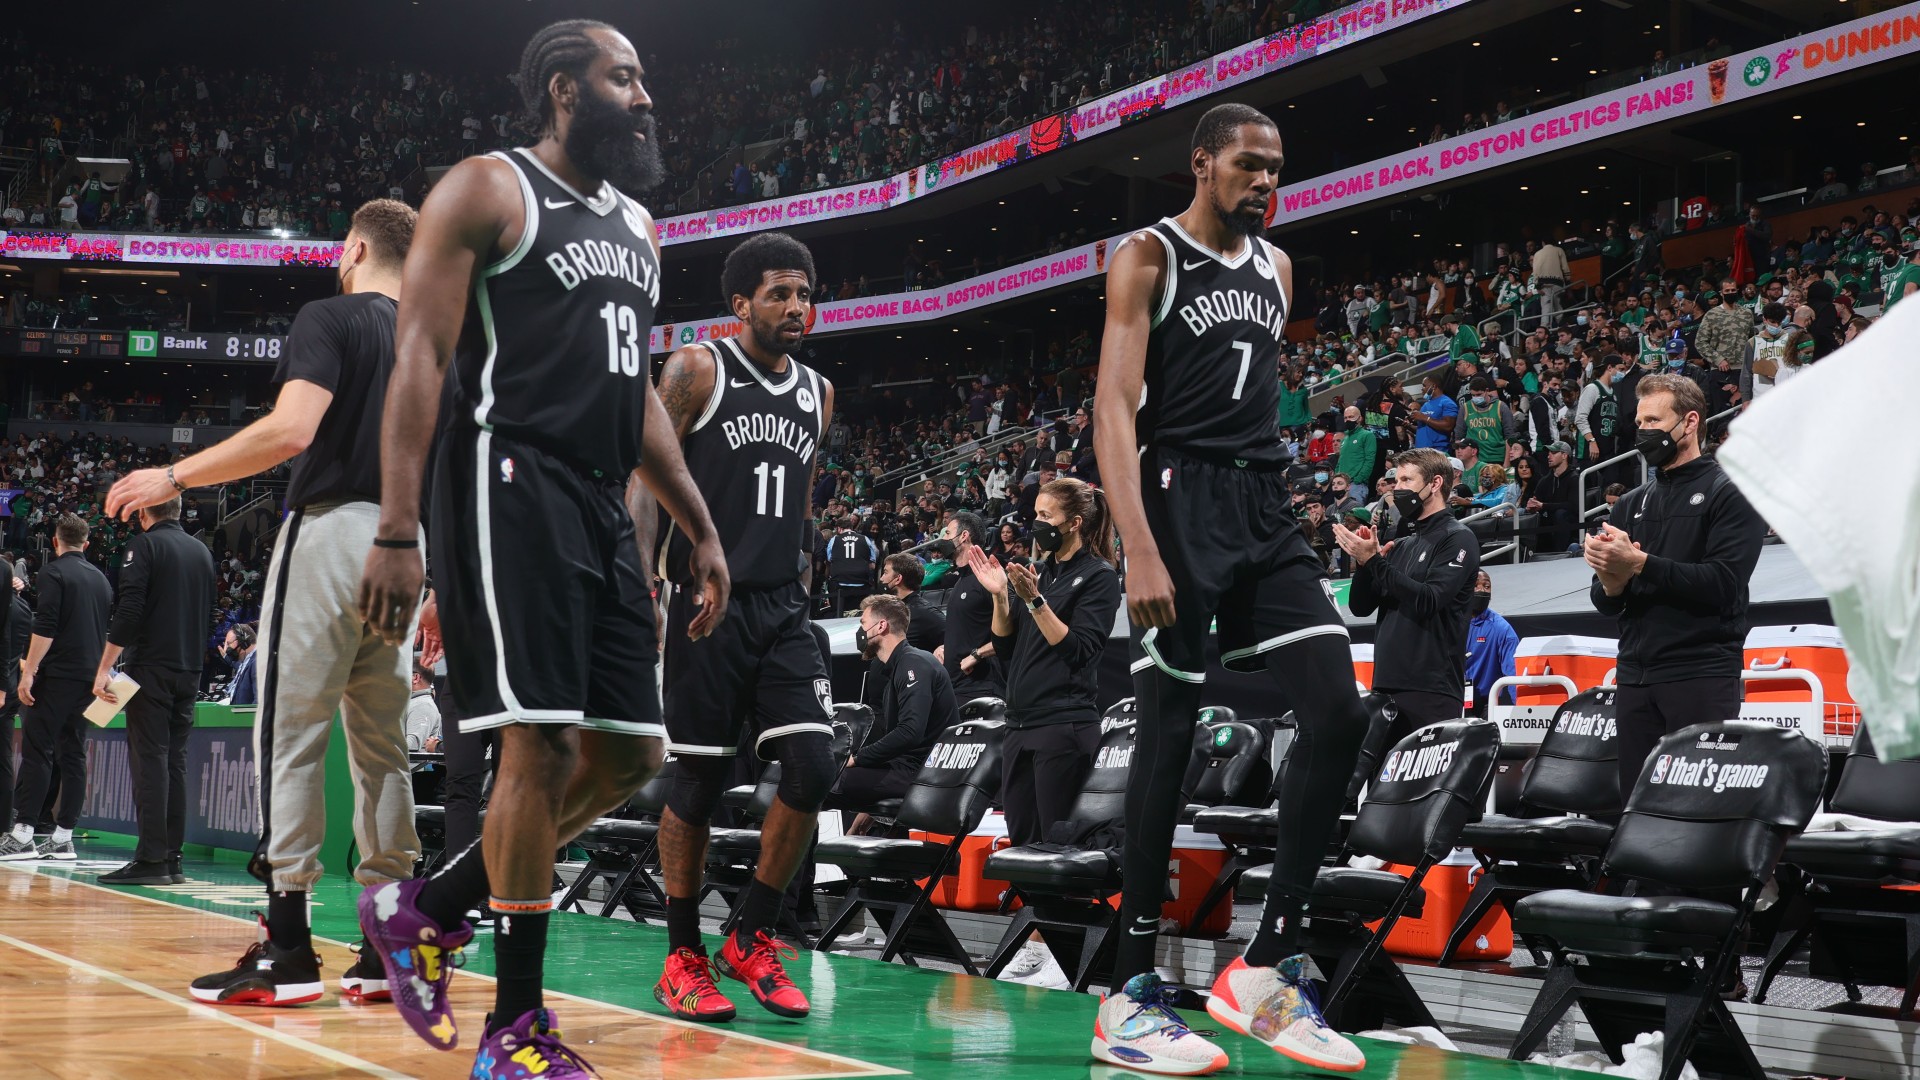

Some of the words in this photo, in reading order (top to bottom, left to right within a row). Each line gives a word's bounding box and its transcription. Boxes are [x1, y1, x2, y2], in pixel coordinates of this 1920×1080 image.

[1216, 33, 1297, 82] BOSTON
[1301, 2, 1386, 51] CELTICS
[1284, 167, 1374, 212] WELCOME
[1378, 157, 1434, 188] BACK,
[1439, 131, 1526, 170] BOSTON
[1530, 102, 1621, 144] CELTICS
[1626, 80, 1694, 118] FANS!
[667, 217, 712, 239] BACK,
[716, 204, 783, 231] BOSTON
[787, 191, 855, 218] CELTICS
[1687, 203, 1703, 219] 12
[0, 235, 61, 253] COME
[130, 240, 210, 257] BOSTON
[216, 242, 294, 261] CELTICS
[545, 239, 660, 308] BROOKLYN
[822, 302, 898, 324] WELCOME
[902, 297, 943, 315] BACK,
[947, 282, 995, 307] BOSTON
[998, 265, 1048, 292] CELTICS
[1050, 253, 1088, 279] FANS!
[1179, 289, 1285, 342] BROOKLYN
[131, 335, 155, 352] TD
[163, 336, 208, 350] Bank
[226, 337, 281, 359] 8:08
[600, 301, 639, 377] 13
[1232, 340, 1253, 400] 7
[177, 430, 190, 441] 19
[721, 412, 815, 465] BROOKLYN
[1469, 417, 1497, 428] BOSTON
[754, 461, 785, 518] 11
[843, 542, 855, 559] 11
[1503, 718, 1552, 729] GATORAD
[1568, 712, 1605, 736] that's
[1601, 718, 1617, 741] ga
[935, 743, 986, 770] PLAYOFFS
[1106, 744, 1135, 769] that'
[1393, 741, 1459, 782] PLAYOFFS
[1667, 756, 1719, 788] that's
[1713, 764, 1769, 793] game
[91, 740, 137, 823] PLAYOF
[200, 741, 262, 835] #Thats
